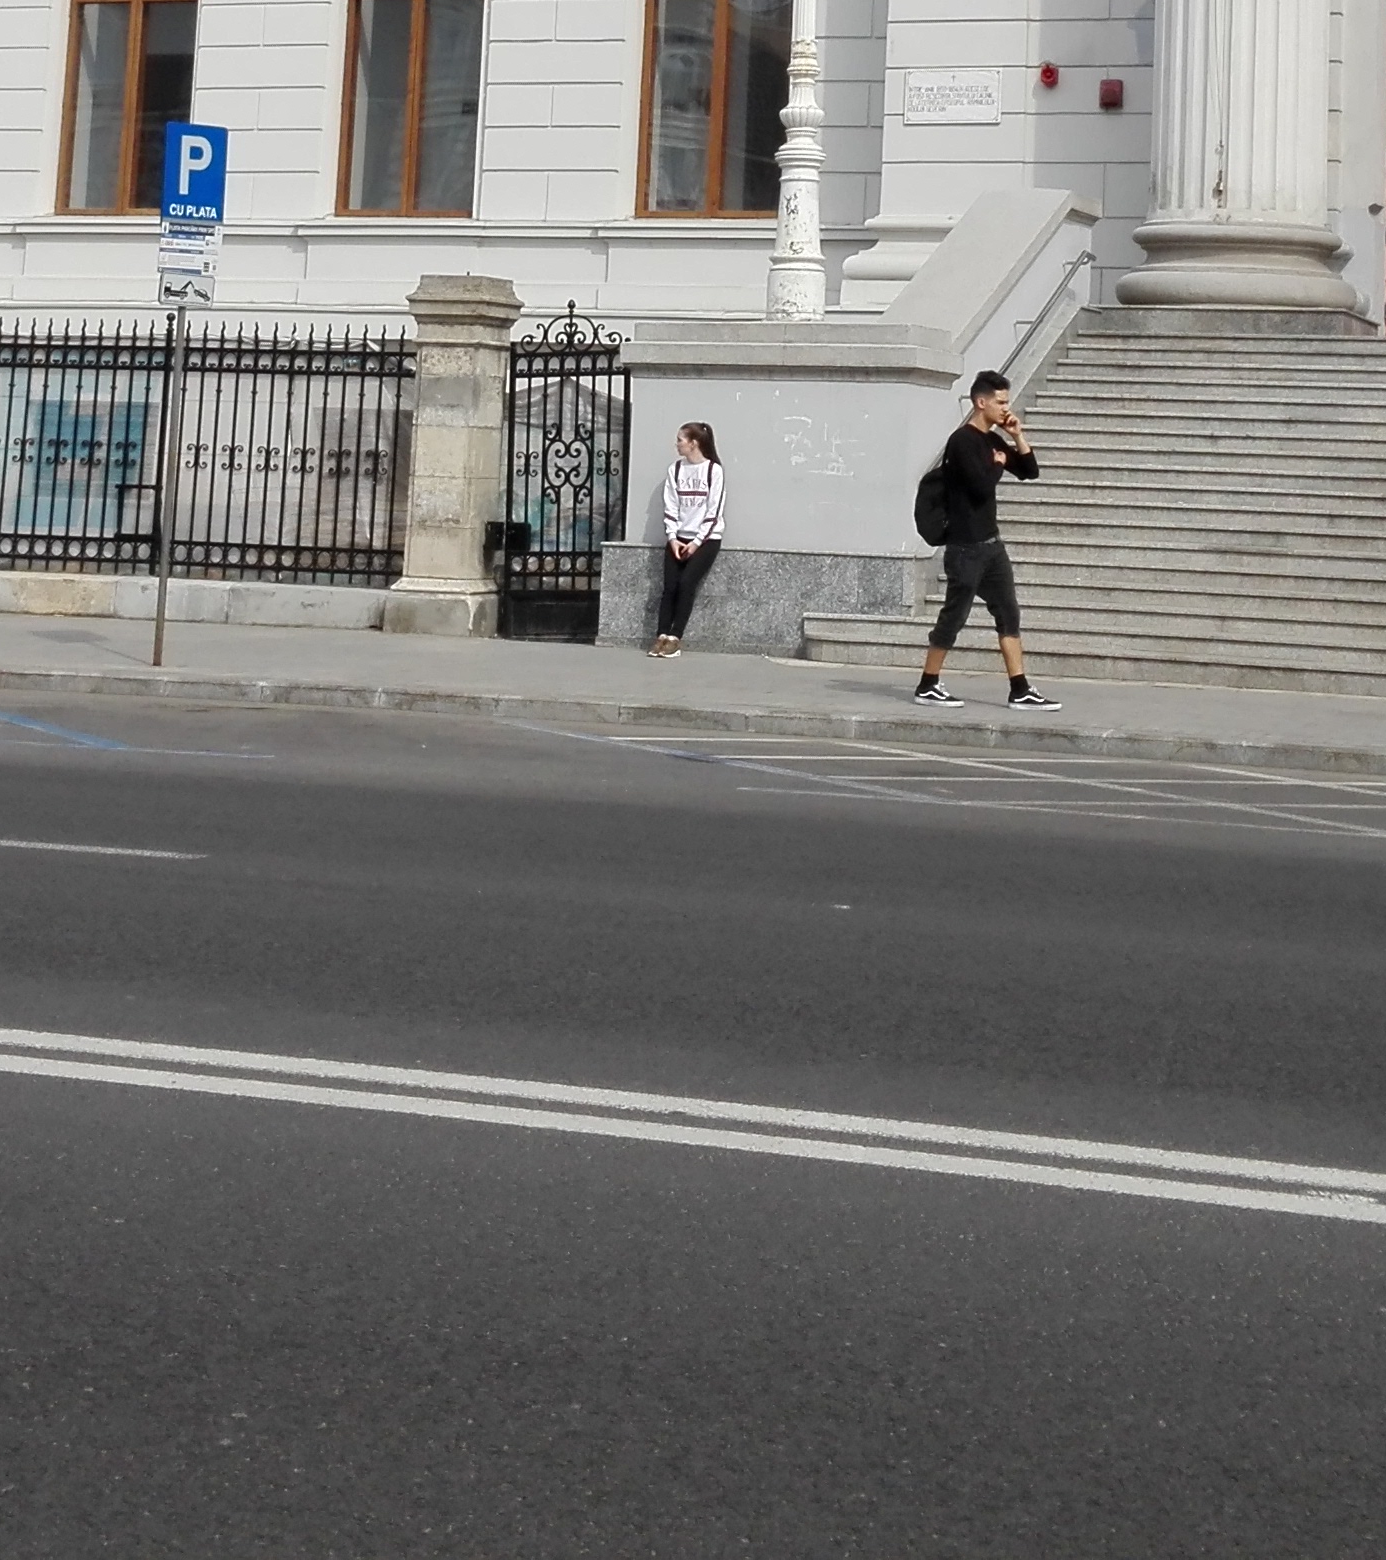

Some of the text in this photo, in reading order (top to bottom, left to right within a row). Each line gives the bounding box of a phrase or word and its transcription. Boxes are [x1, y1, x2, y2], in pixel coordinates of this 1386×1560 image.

[178, 134, 213, 195] P
[169, 203, 217, 219] CU PLATA
